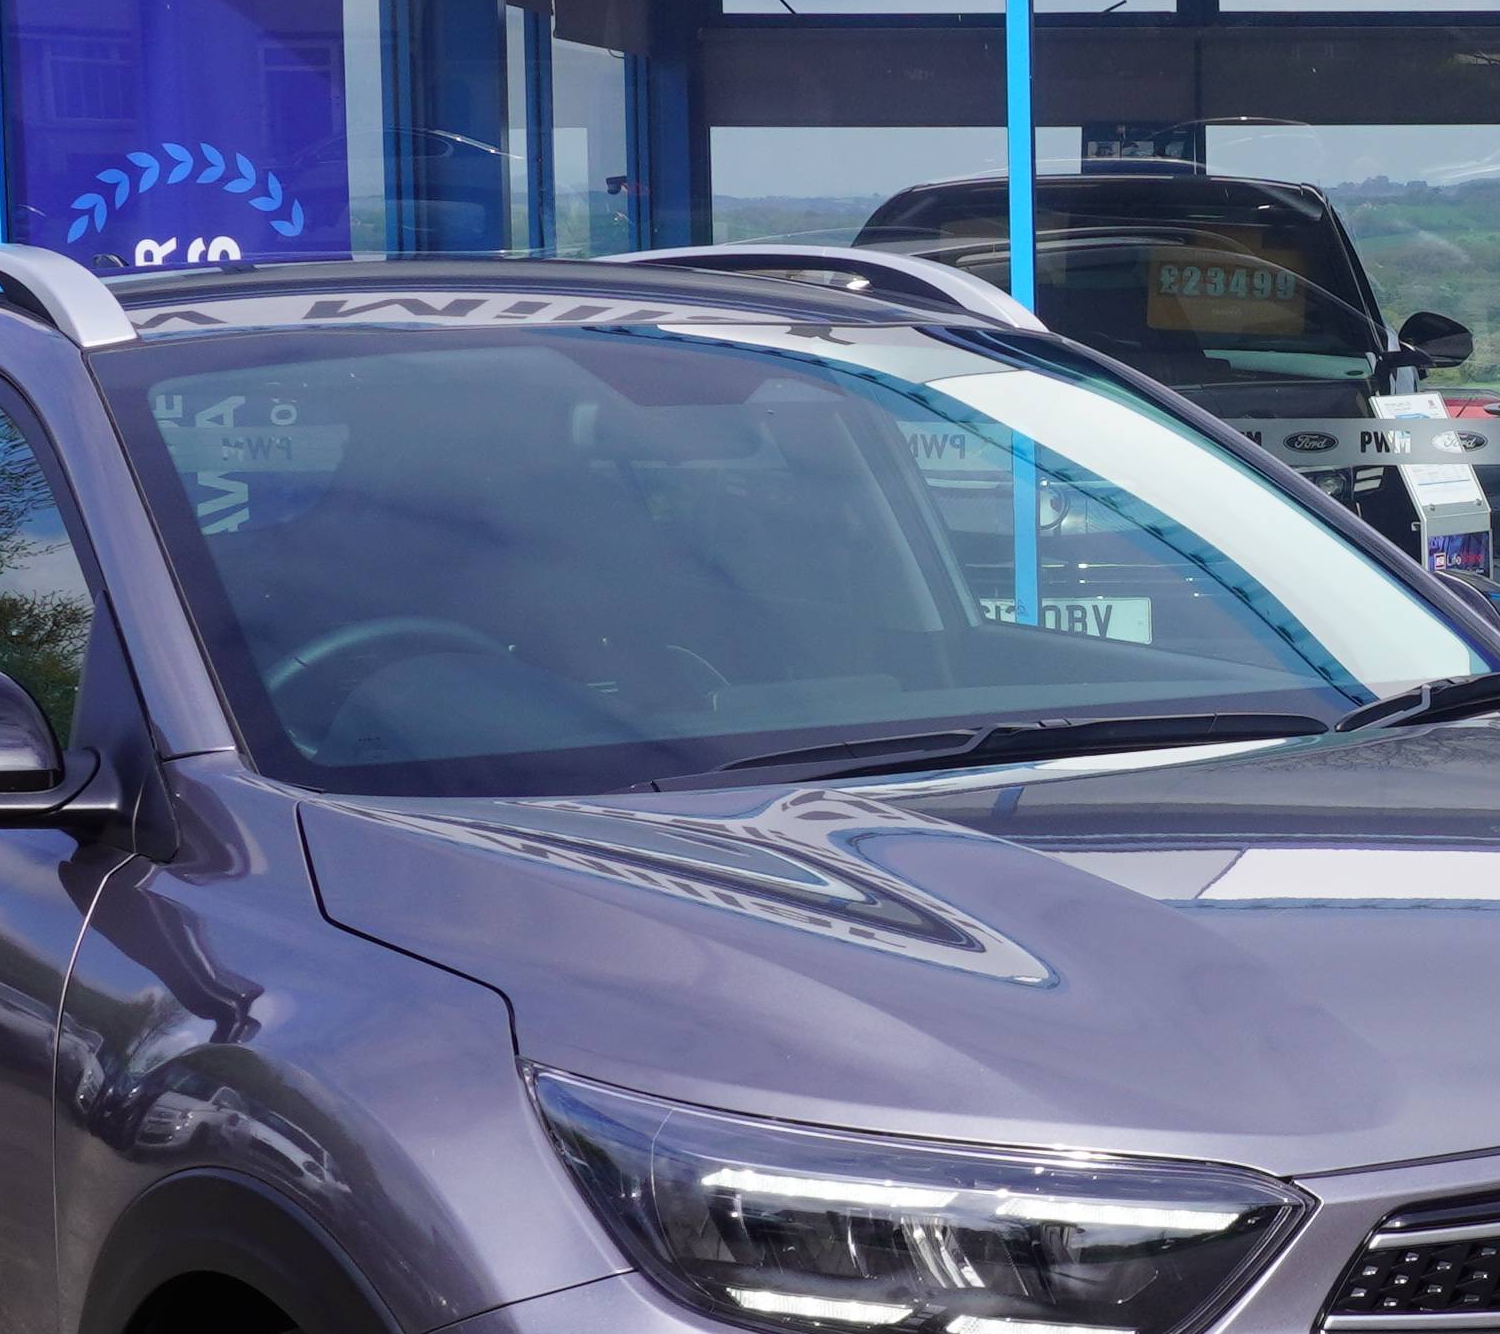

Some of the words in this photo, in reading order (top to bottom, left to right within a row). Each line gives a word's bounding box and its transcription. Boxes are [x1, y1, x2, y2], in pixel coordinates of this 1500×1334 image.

[1159, 265, 1297, 299] £23499
[1286, 433, 1335, 450] Ford
[1360, 430, 1411, 453] PWM
